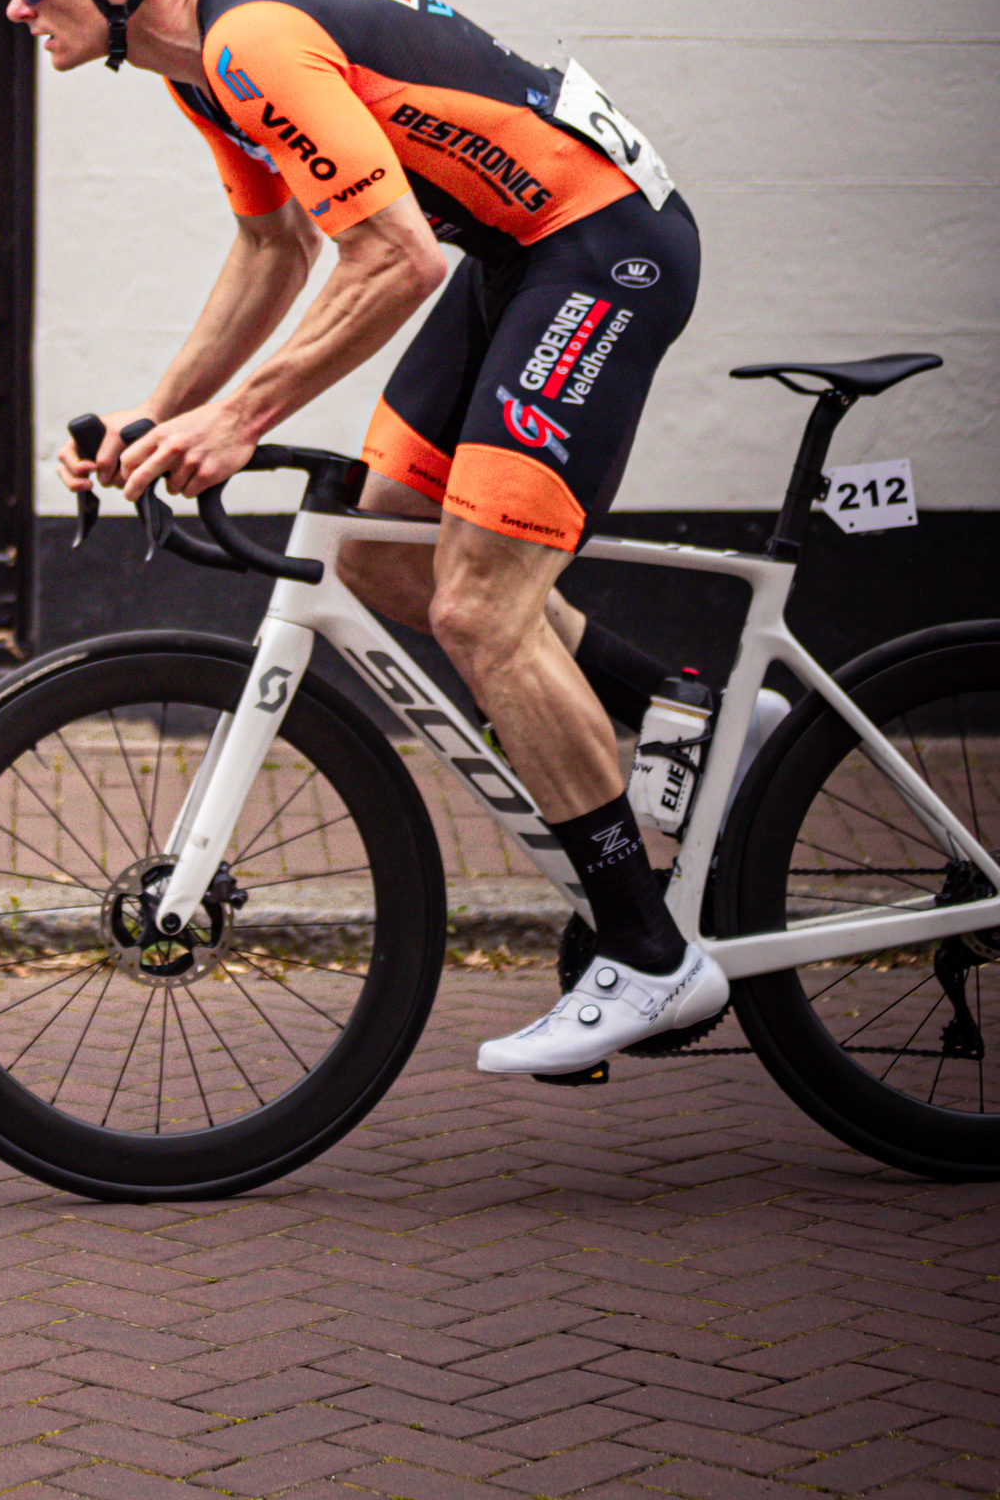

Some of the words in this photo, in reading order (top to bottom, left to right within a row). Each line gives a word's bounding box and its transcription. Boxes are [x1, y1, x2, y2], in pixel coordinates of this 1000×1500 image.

[261, 101, 337, 181] VIRO
[332, 168, 386, 202] VIRO
[389, 103, 553, 214] BESTRONICS
[519, 292, 596, 390] GROENEN
[555, 319, 594, 375] GROEP
[561, 308, 634, 405] Veldhoven
[837, 477, 908, 511] 212
[344, 647, 583, 900] SCOT
